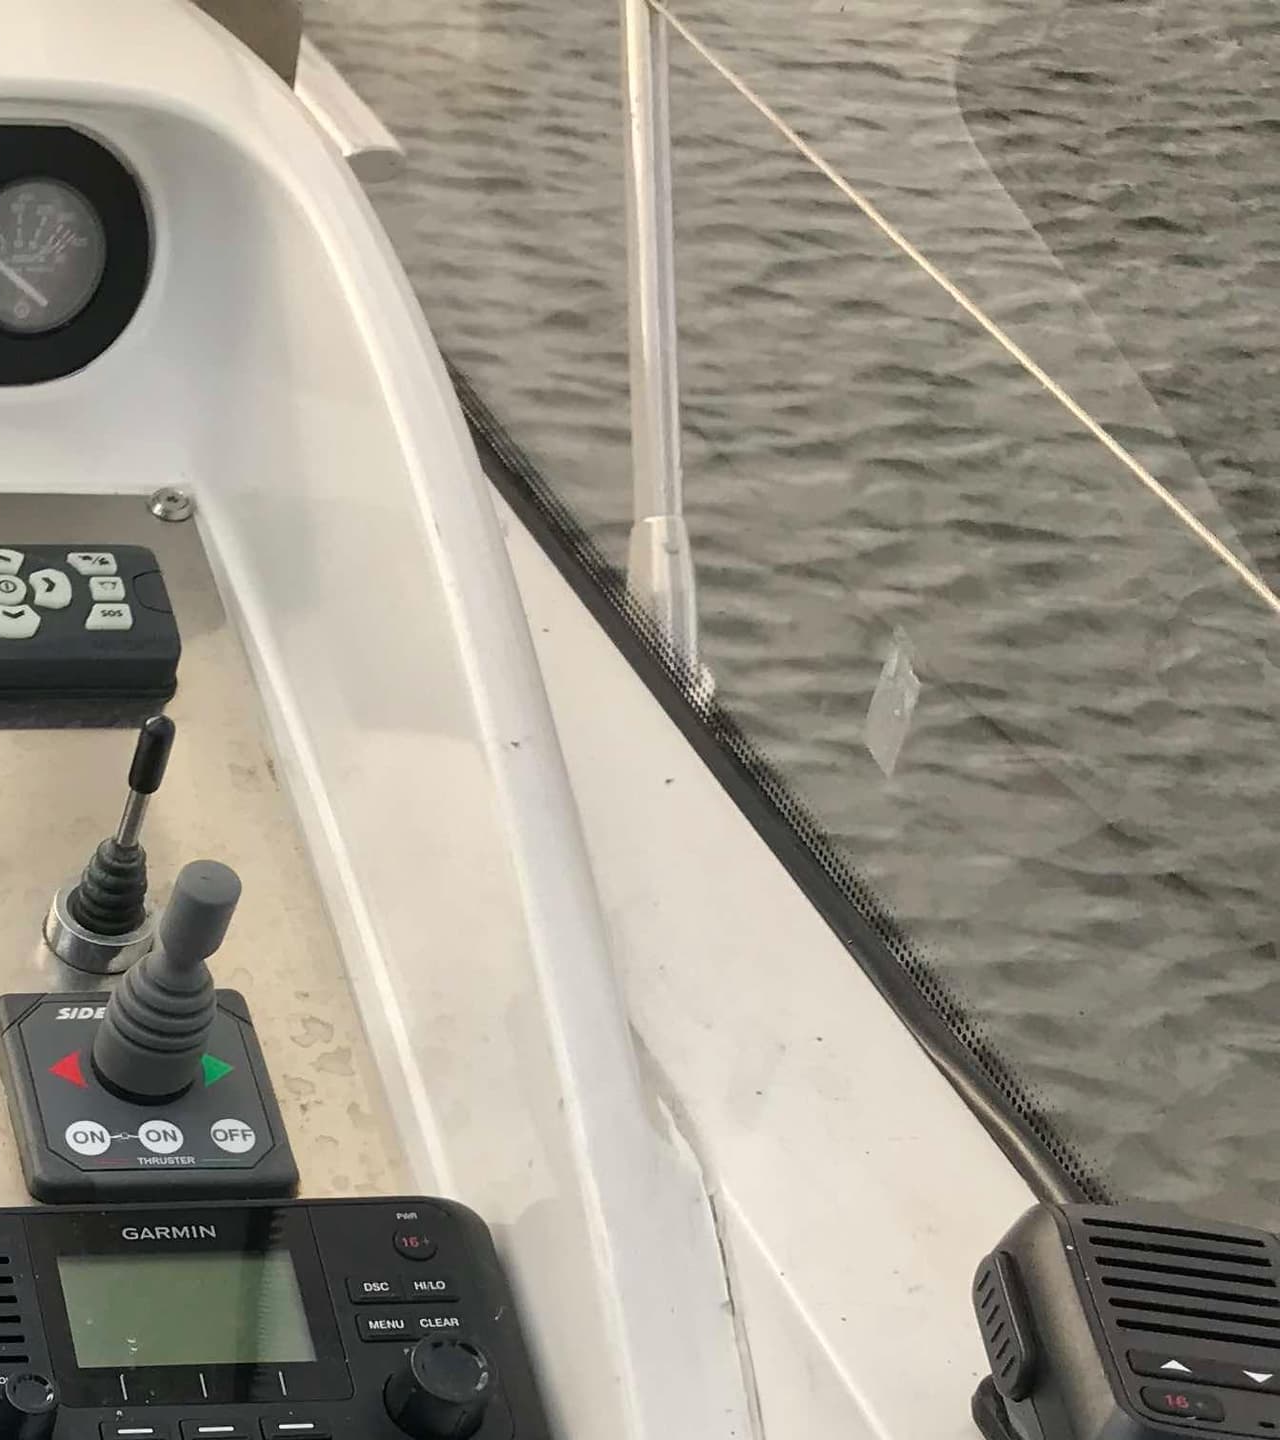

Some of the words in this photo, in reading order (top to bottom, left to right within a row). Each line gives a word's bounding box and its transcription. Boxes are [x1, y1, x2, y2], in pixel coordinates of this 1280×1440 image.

[101, 609, 123, 617] SOS
[73, 1131, 105, 1144] ON
[145, 1129, 178, 1143] ON
[212, 1128, 254, 1142] OFF
[137, 1156, 196, 1166] THRUSTER
[122, 1225, 217, 1240] GARMIN
[364, 1281, 390, 1292] DSC
[414, 1280, 446, 1291] HI/LO
[368, 1319, 405, 1330] MENU
[419, 1317, 459, 1328] CLEAR
